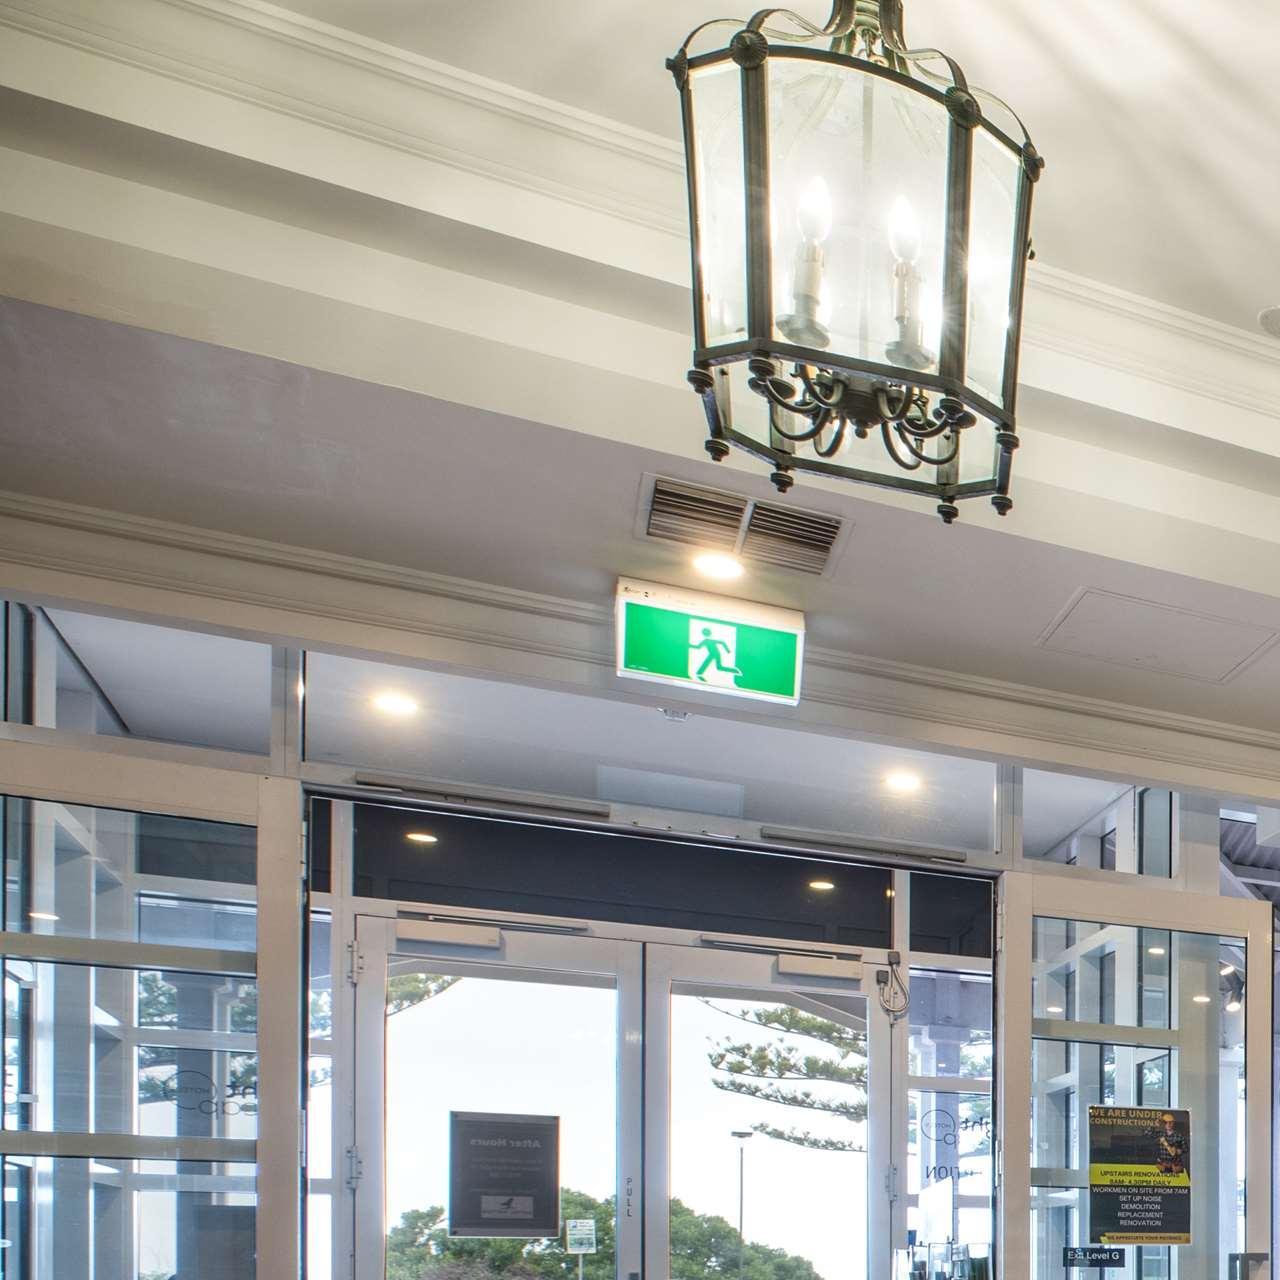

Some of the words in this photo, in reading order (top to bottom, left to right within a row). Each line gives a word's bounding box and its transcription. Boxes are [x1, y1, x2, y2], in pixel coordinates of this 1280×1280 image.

[1107, 1109, 1127, 1117] ARE
[1129, 1110, 1162, 1118] UNDER
[1086, 1251, 1110, 1260] Level
[1111, 1251, 1120, 1260] G
